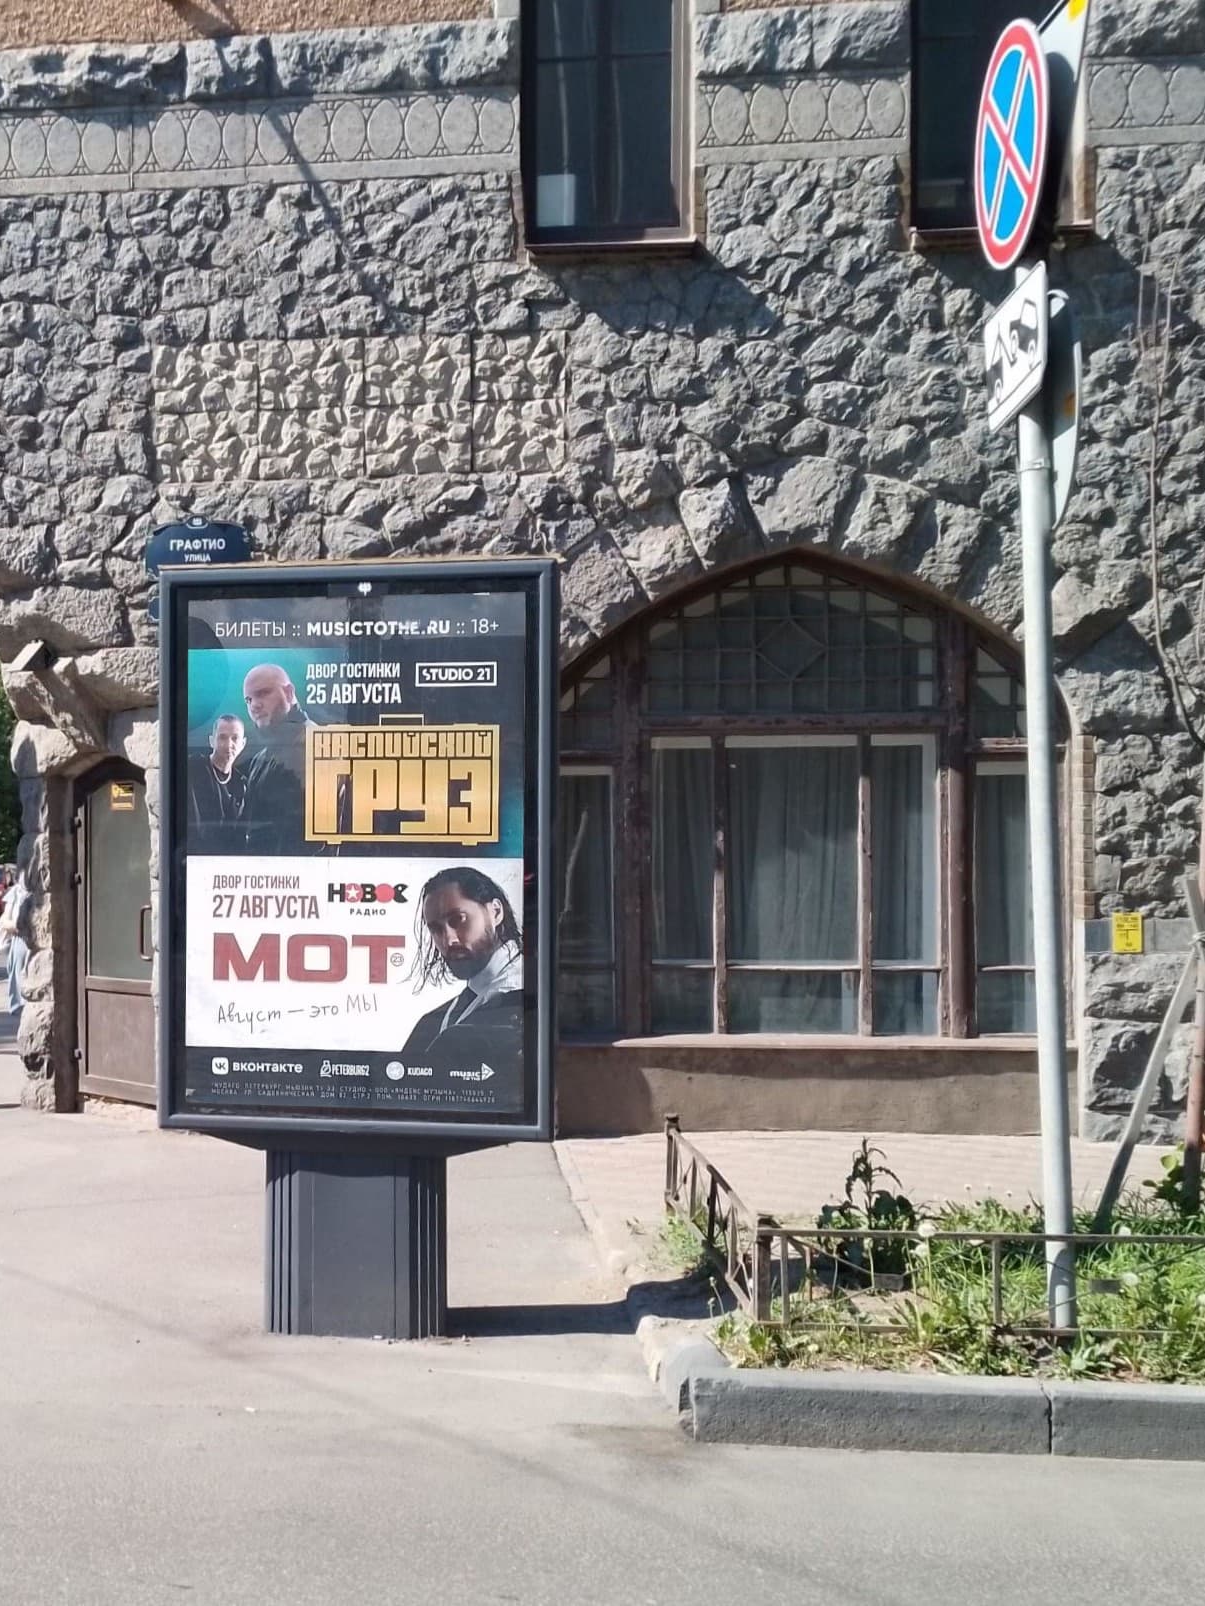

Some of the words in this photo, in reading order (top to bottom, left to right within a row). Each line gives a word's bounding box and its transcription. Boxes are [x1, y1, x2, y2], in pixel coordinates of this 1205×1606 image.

[169, 538, 226, 551] ГРАФТИО
[184, 553, 212, 562] УЛИЦА
[214, 621, 286, 637] БИЛЕТЫ
[306, 619, 451, 637] MUSICTOTHE.RU
[471, 619, 500, 634] 18+
[306, 663, 338, 680] ДВОР
[340, 661, 401, 679] ГОСТИНКИ
[422, 667, 473, 682] STUDIO
[476, 667, 491, 681] 21
[306, 684, 327, 705] 25
[330, 683, 402, 705] АВГУСТА
[313, 731, 492, 758] КАСПИЙСКИЙ
[313, 759, 491, 835] ГРУЗ
[212, 875, 242, 890] ДВОР
[244, 874, 300, 890] ГОСТИНКИ
[212, 894, 235, 919] 27
[239, 895, 320, 920] АВГУСТА
[349, 908, 387, 916] РАДИО
[212, 932, 406, 985] МОТ
[217, 1001, 282, 1034] Август
[309, 1005, 339, 1018] это
[346, 993, 378, 1013] МЫ
